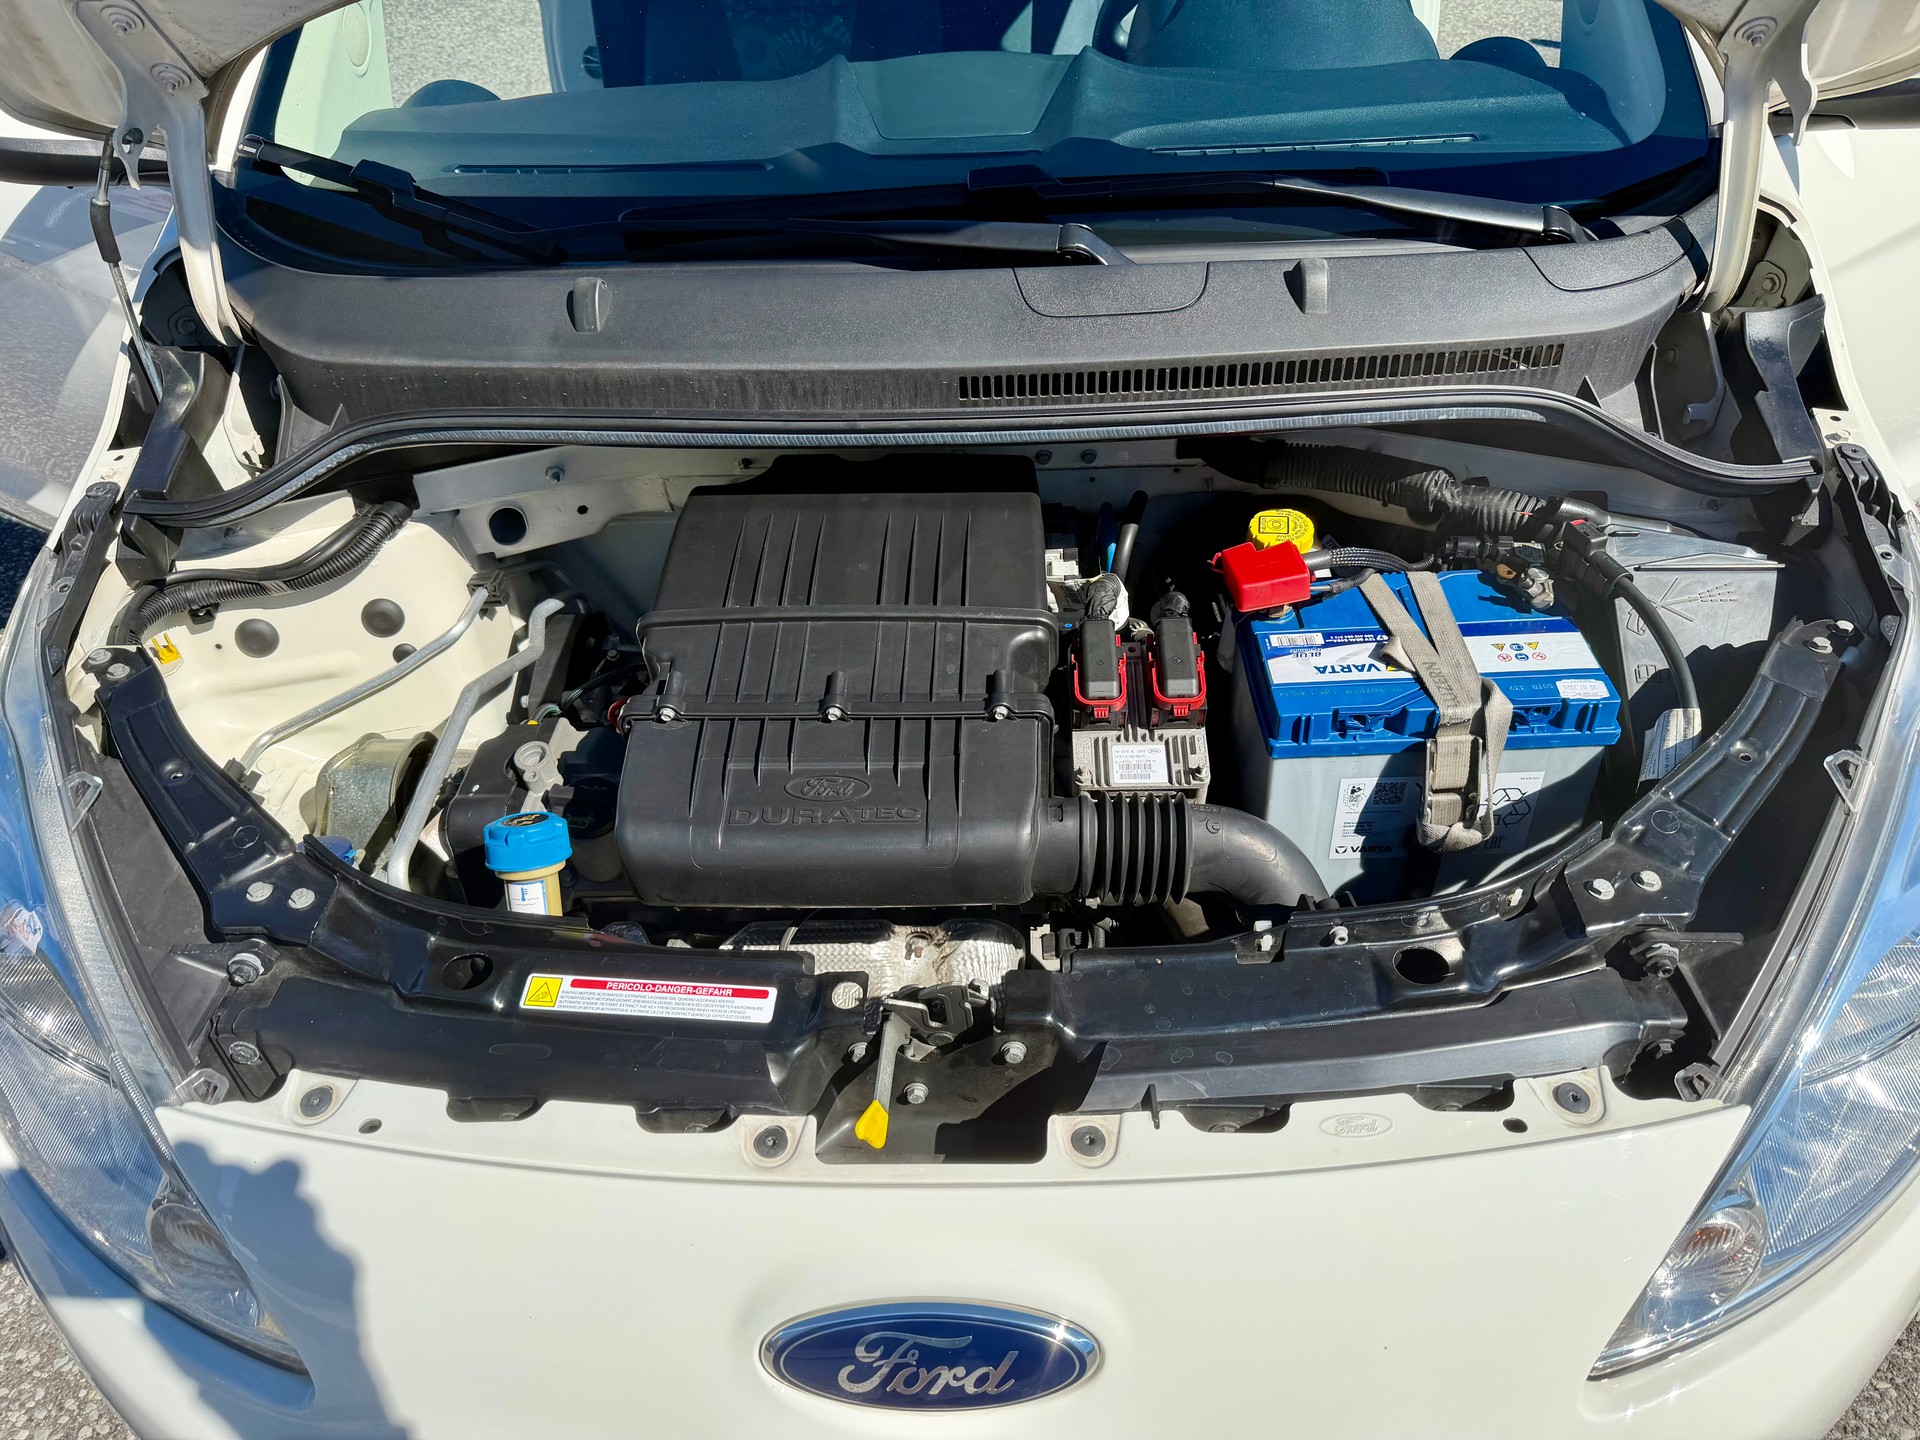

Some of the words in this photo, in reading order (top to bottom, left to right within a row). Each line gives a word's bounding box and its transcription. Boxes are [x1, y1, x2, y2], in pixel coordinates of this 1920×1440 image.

[1312, 663, 1382, 675] VARTA
[800, 777, 855, 798] Ford
[727, 806, 922, 825] DURATEC
[606, 982, 732, 996] PERICOLO-DANGER-GEFAHR
[1334, 1115, 1378, 1135] Ford
[837, 1331, 1019, 1396] Ford
